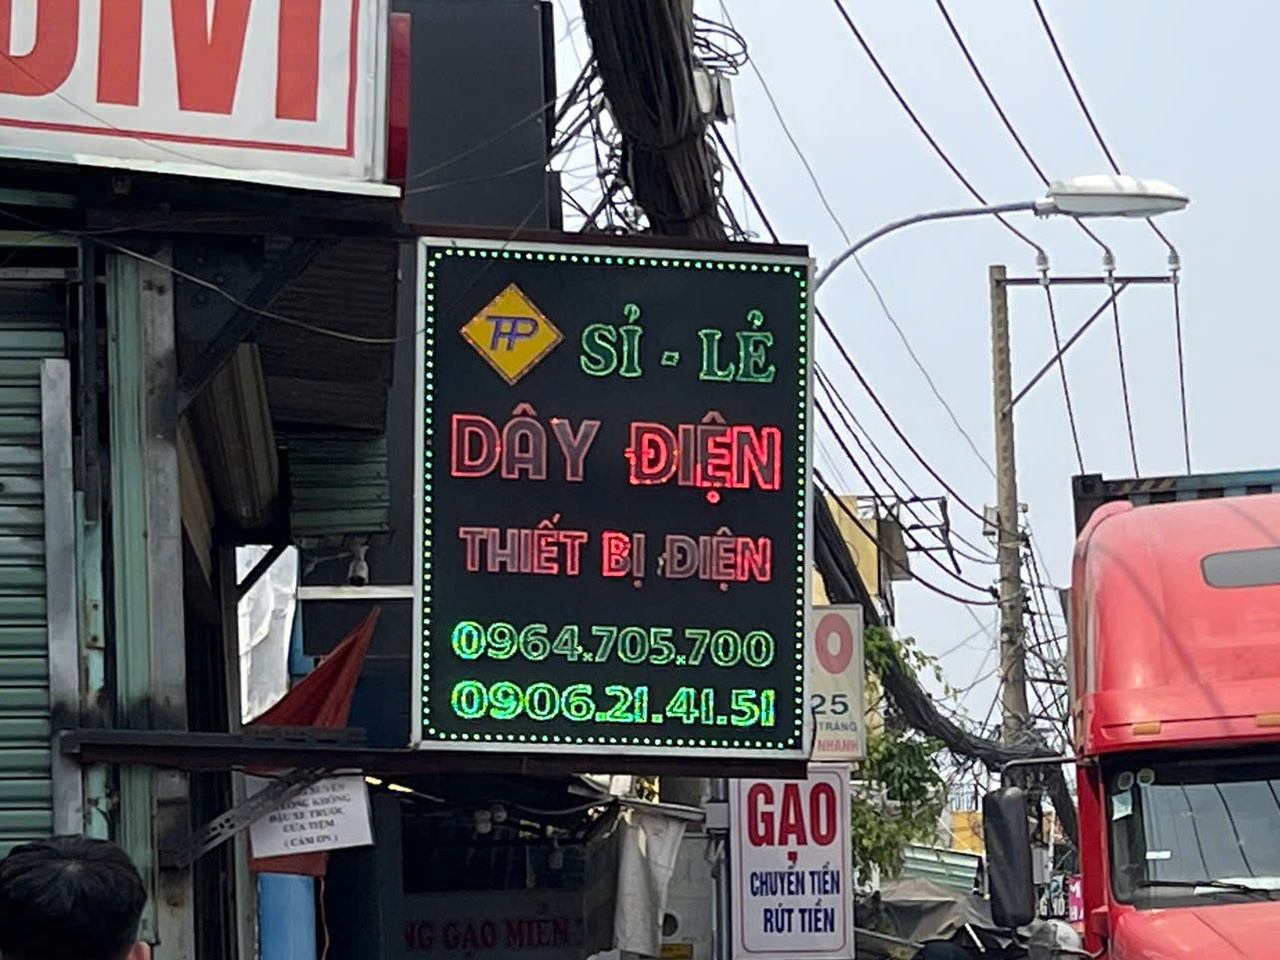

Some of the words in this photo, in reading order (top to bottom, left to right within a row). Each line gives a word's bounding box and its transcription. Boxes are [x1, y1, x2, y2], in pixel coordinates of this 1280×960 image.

[580, 303, 644, 378] SỈ
[699, 309, 776, 383] LẺ
[450, 402, 601, 482] DÂY
[624, 410, 782, 504] ĐIỆN
[458, 513, 589, 577] THIẾT
[601, 529, 646, 589] BỊ
[660, 526, 772, 591] ĐIỆN
[451, 621, 775, 667] 0964.705.700
[451, 679, 775, 727] 0906.21.41.51
[747, 782, 838, 862] GẠO
[763, 902, 795, 933] RÚT
